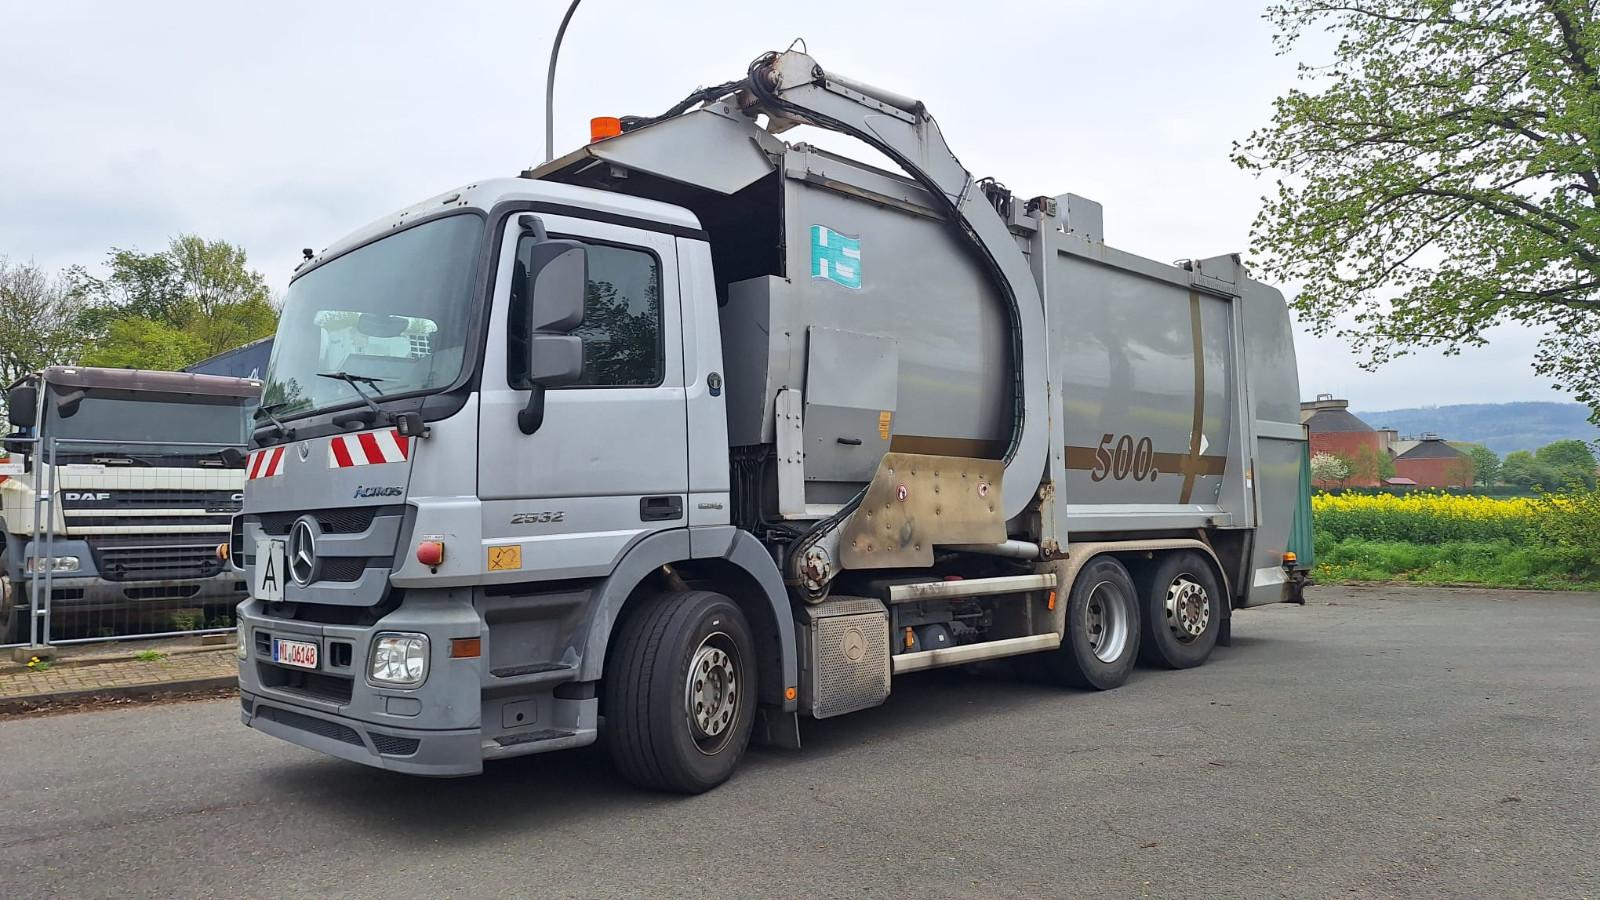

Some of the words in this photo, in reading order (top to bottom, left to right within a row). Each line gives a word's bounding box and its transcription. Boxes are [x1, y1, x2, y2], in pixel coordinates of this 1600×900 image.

[65, 492, 110, 501] DAF
[510, 511, 565, 524] 2532
[262, 547, 277, 592] A
